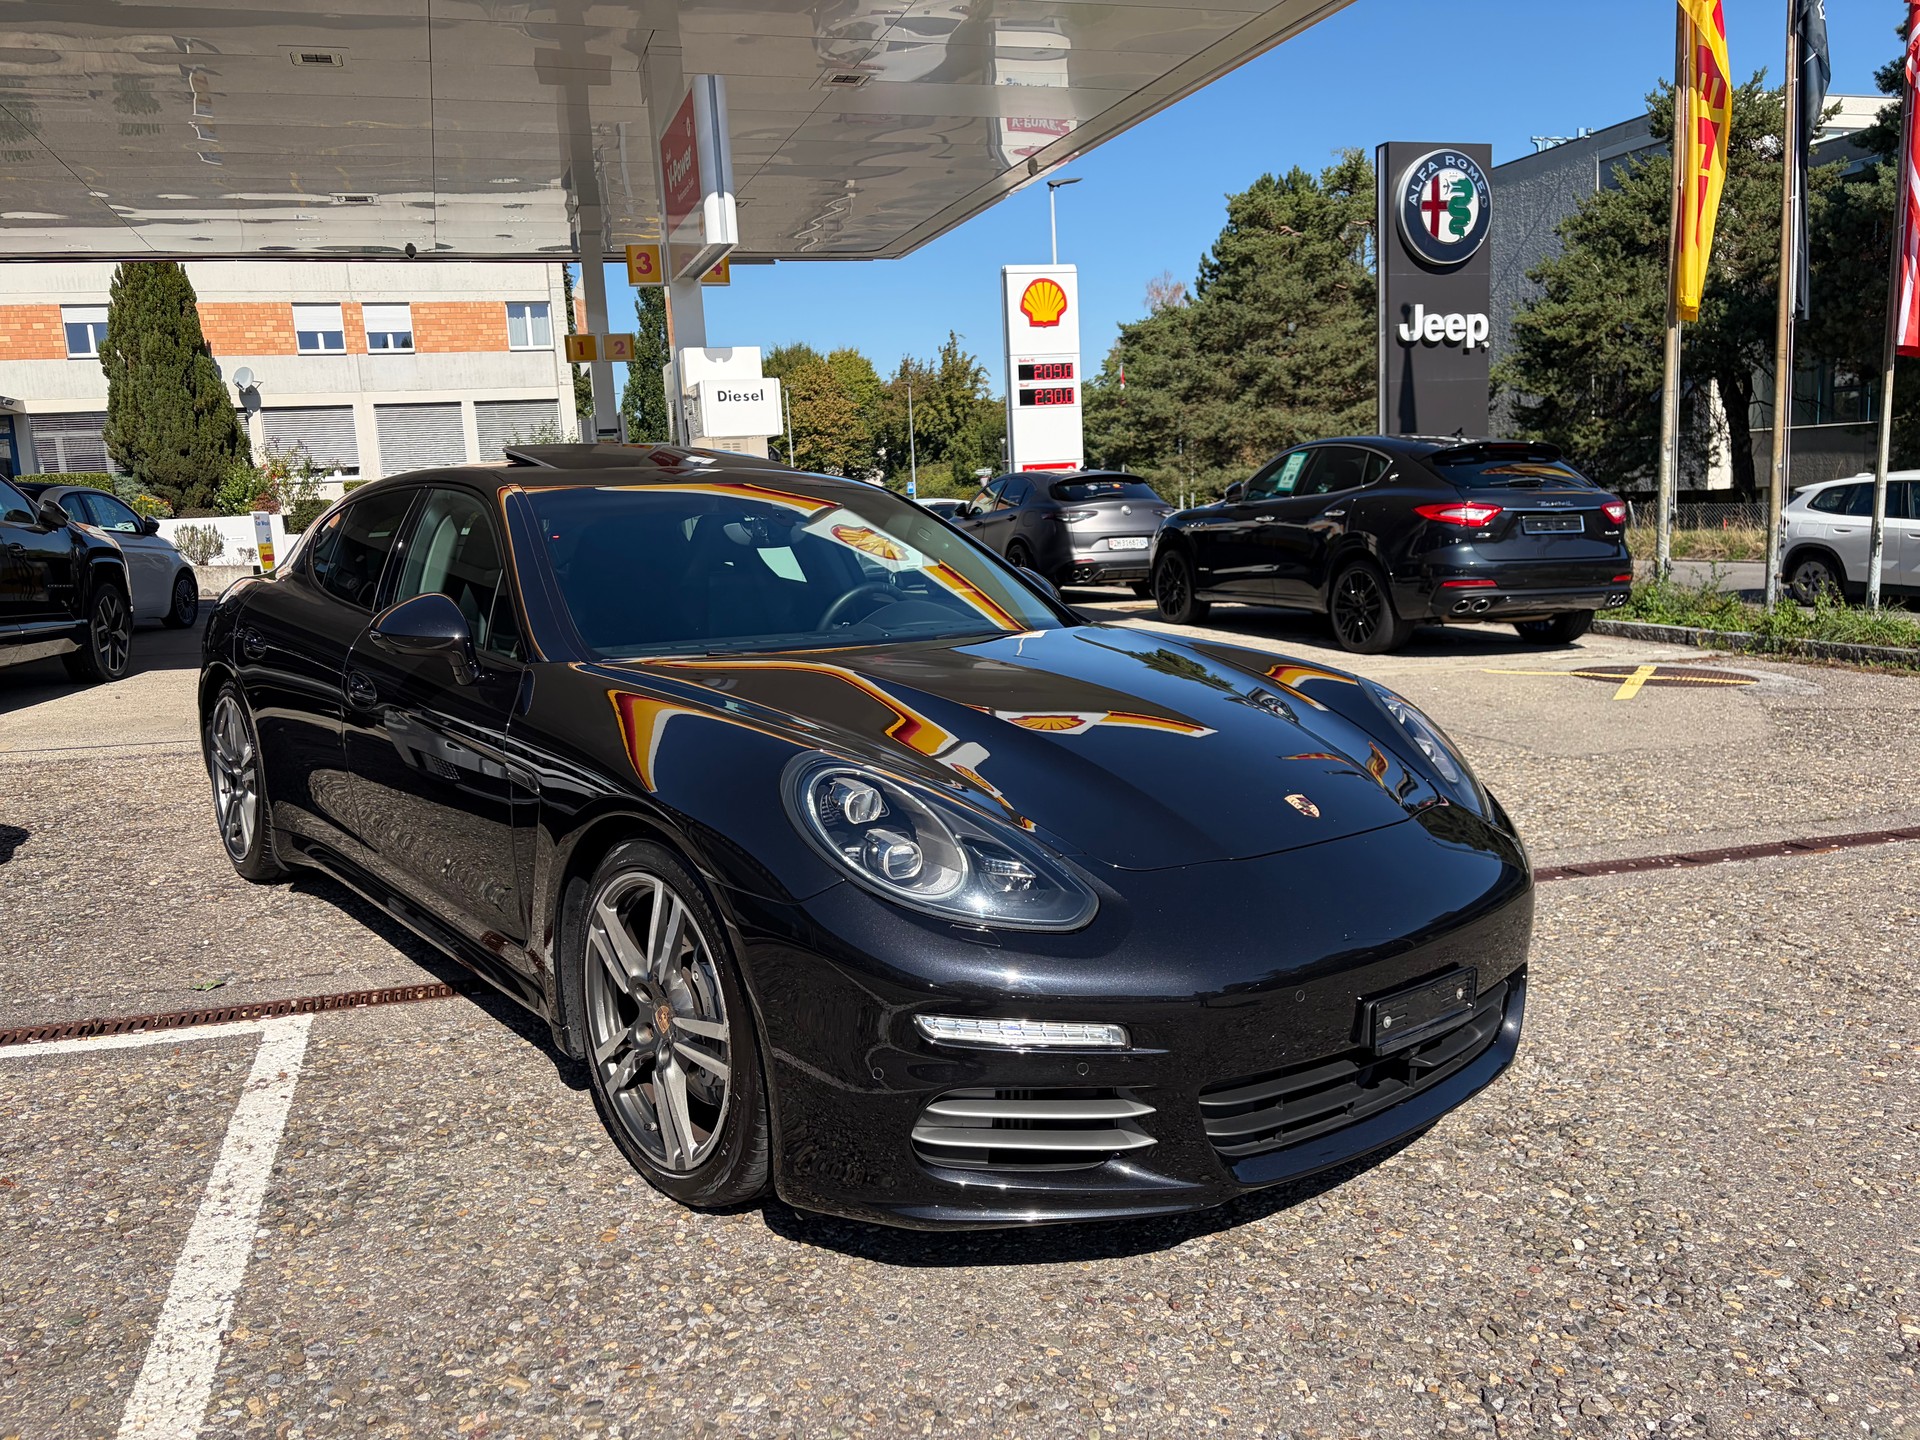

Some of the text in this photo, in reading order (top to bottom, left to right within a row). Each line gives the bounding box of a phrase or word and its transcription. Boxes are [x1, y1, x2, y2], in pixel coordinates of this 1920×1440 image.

[667, 144, 692, 189] V-Power
[1408, 155, 1488, 208] ALFA ROMEO
[636, 252, 653, 275] 3
[1399, 304, 1489, 349] Jeep
[577, 341, 585, 356] 1
[613, 341, 626, 355] 2
[1034, 363, 1074, 380] 209.0
[717, 388, 764, 402] Diesel
[1035, 388, 1075, 406] 230.0
